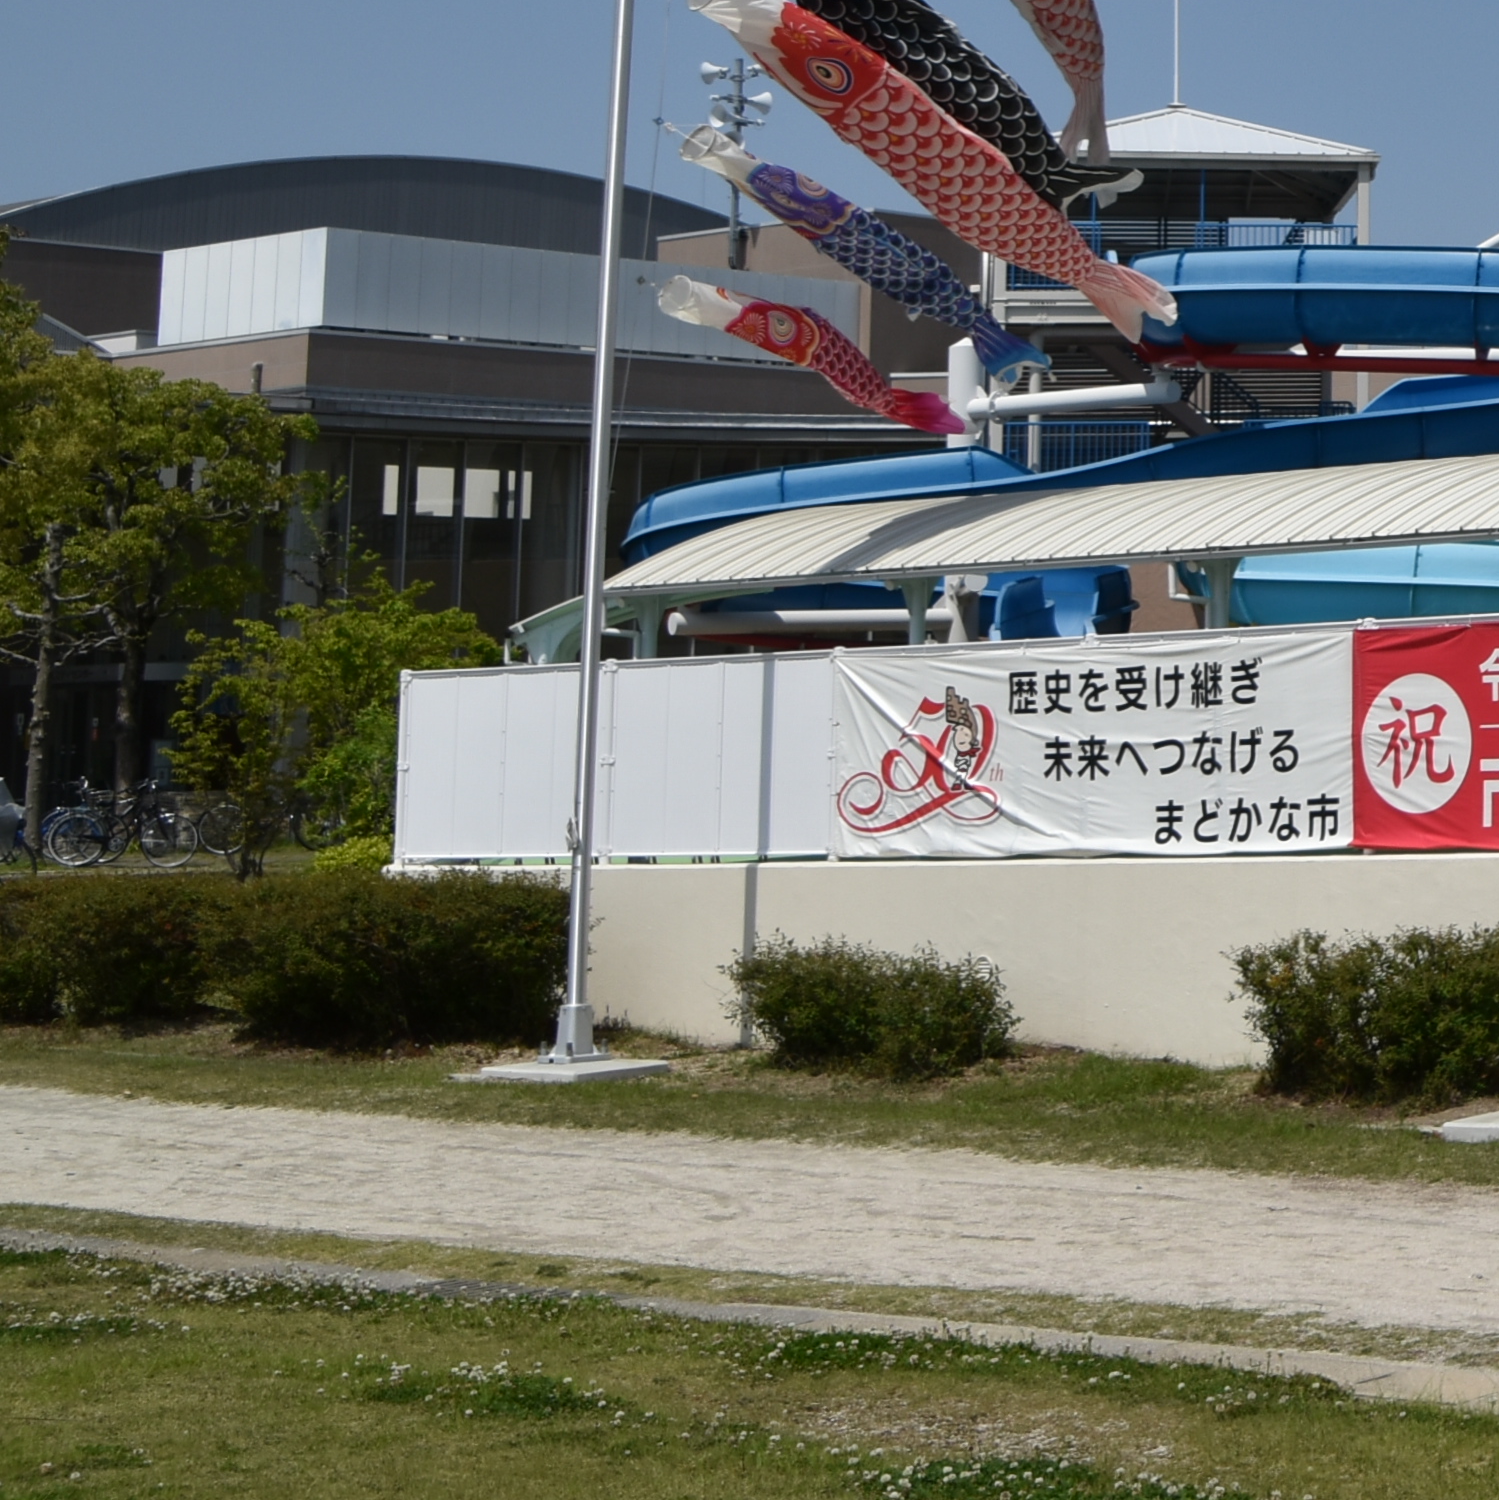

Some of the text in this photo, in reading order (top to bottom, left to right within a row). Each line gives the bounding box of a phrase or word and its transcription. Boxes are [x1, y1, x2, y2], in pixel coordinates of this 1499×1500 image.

[1008, 658, 1261, 715] 歴史を受け継ぎ
[1043, 730, 1299, 782] 未来へつなげる
[1377, 697, 1456, 789] 祝
[1155, 794, 1340, 845] まどかな市
